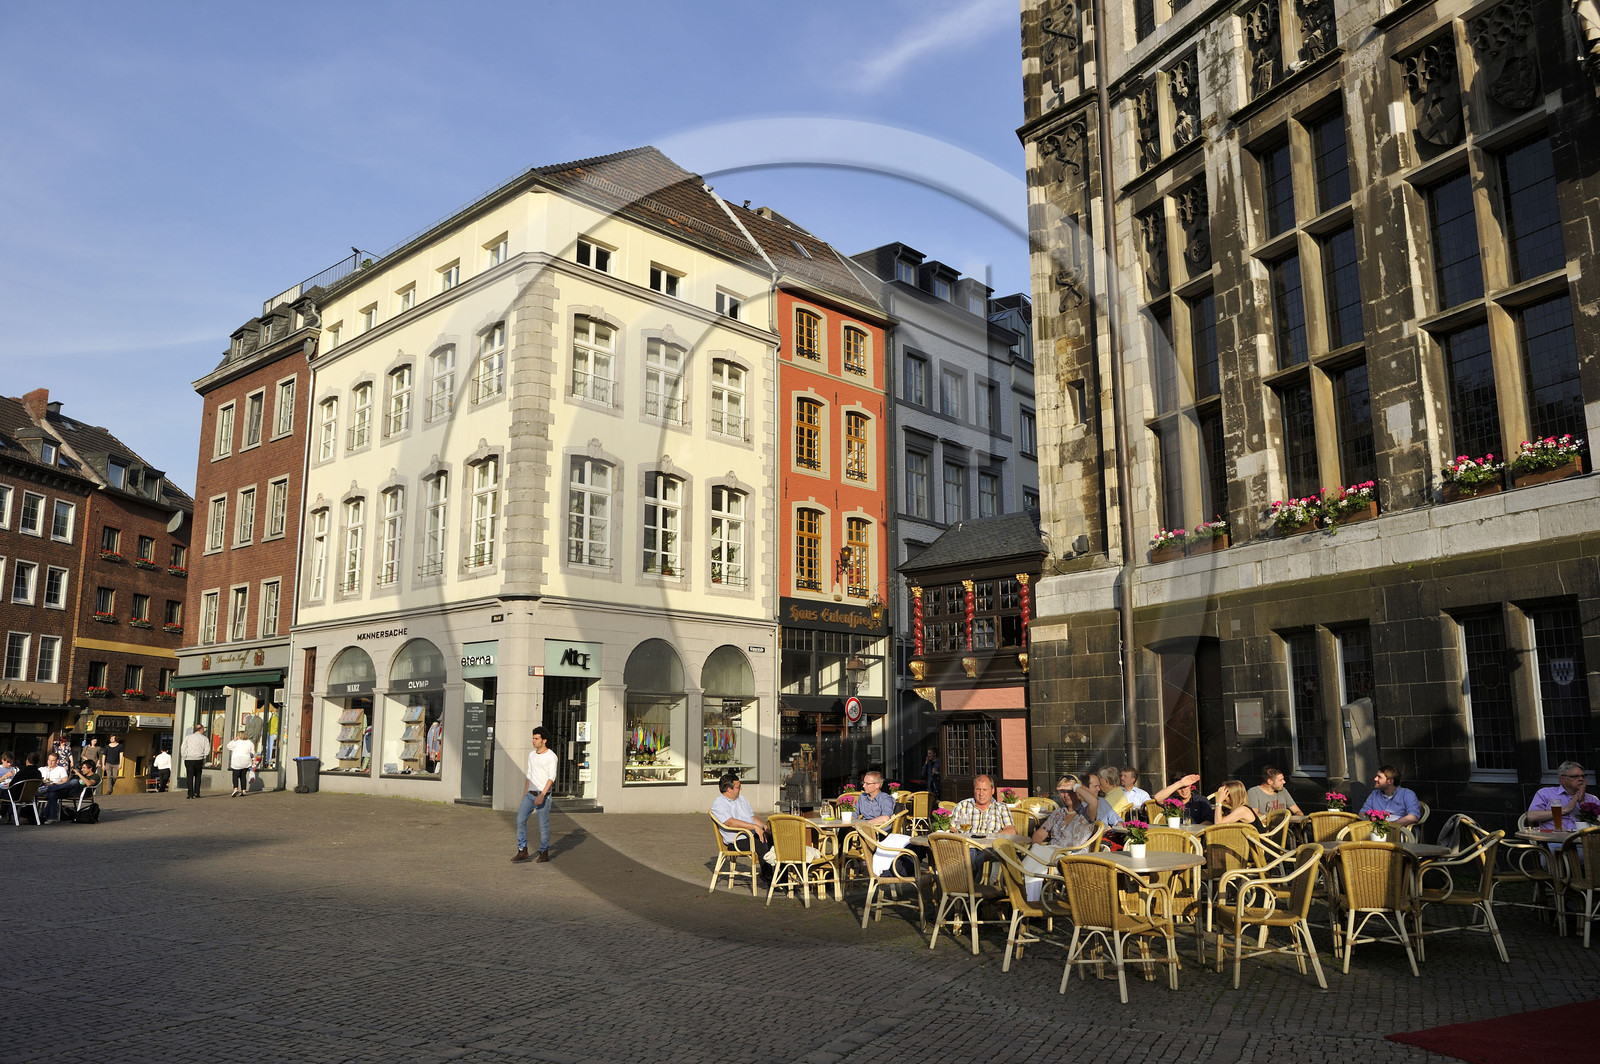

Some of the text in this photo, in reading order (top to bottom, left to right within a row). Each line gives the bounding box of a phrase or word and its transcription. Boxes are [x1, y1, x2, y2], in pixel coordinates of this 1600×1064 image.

[357, 628, 408, 641] MÄNNERSACHE
[461, 655, 492, 666] eterna
[408, 681, 429, 689] OLYMP
[98, 719, 128, 727] HOTEL
